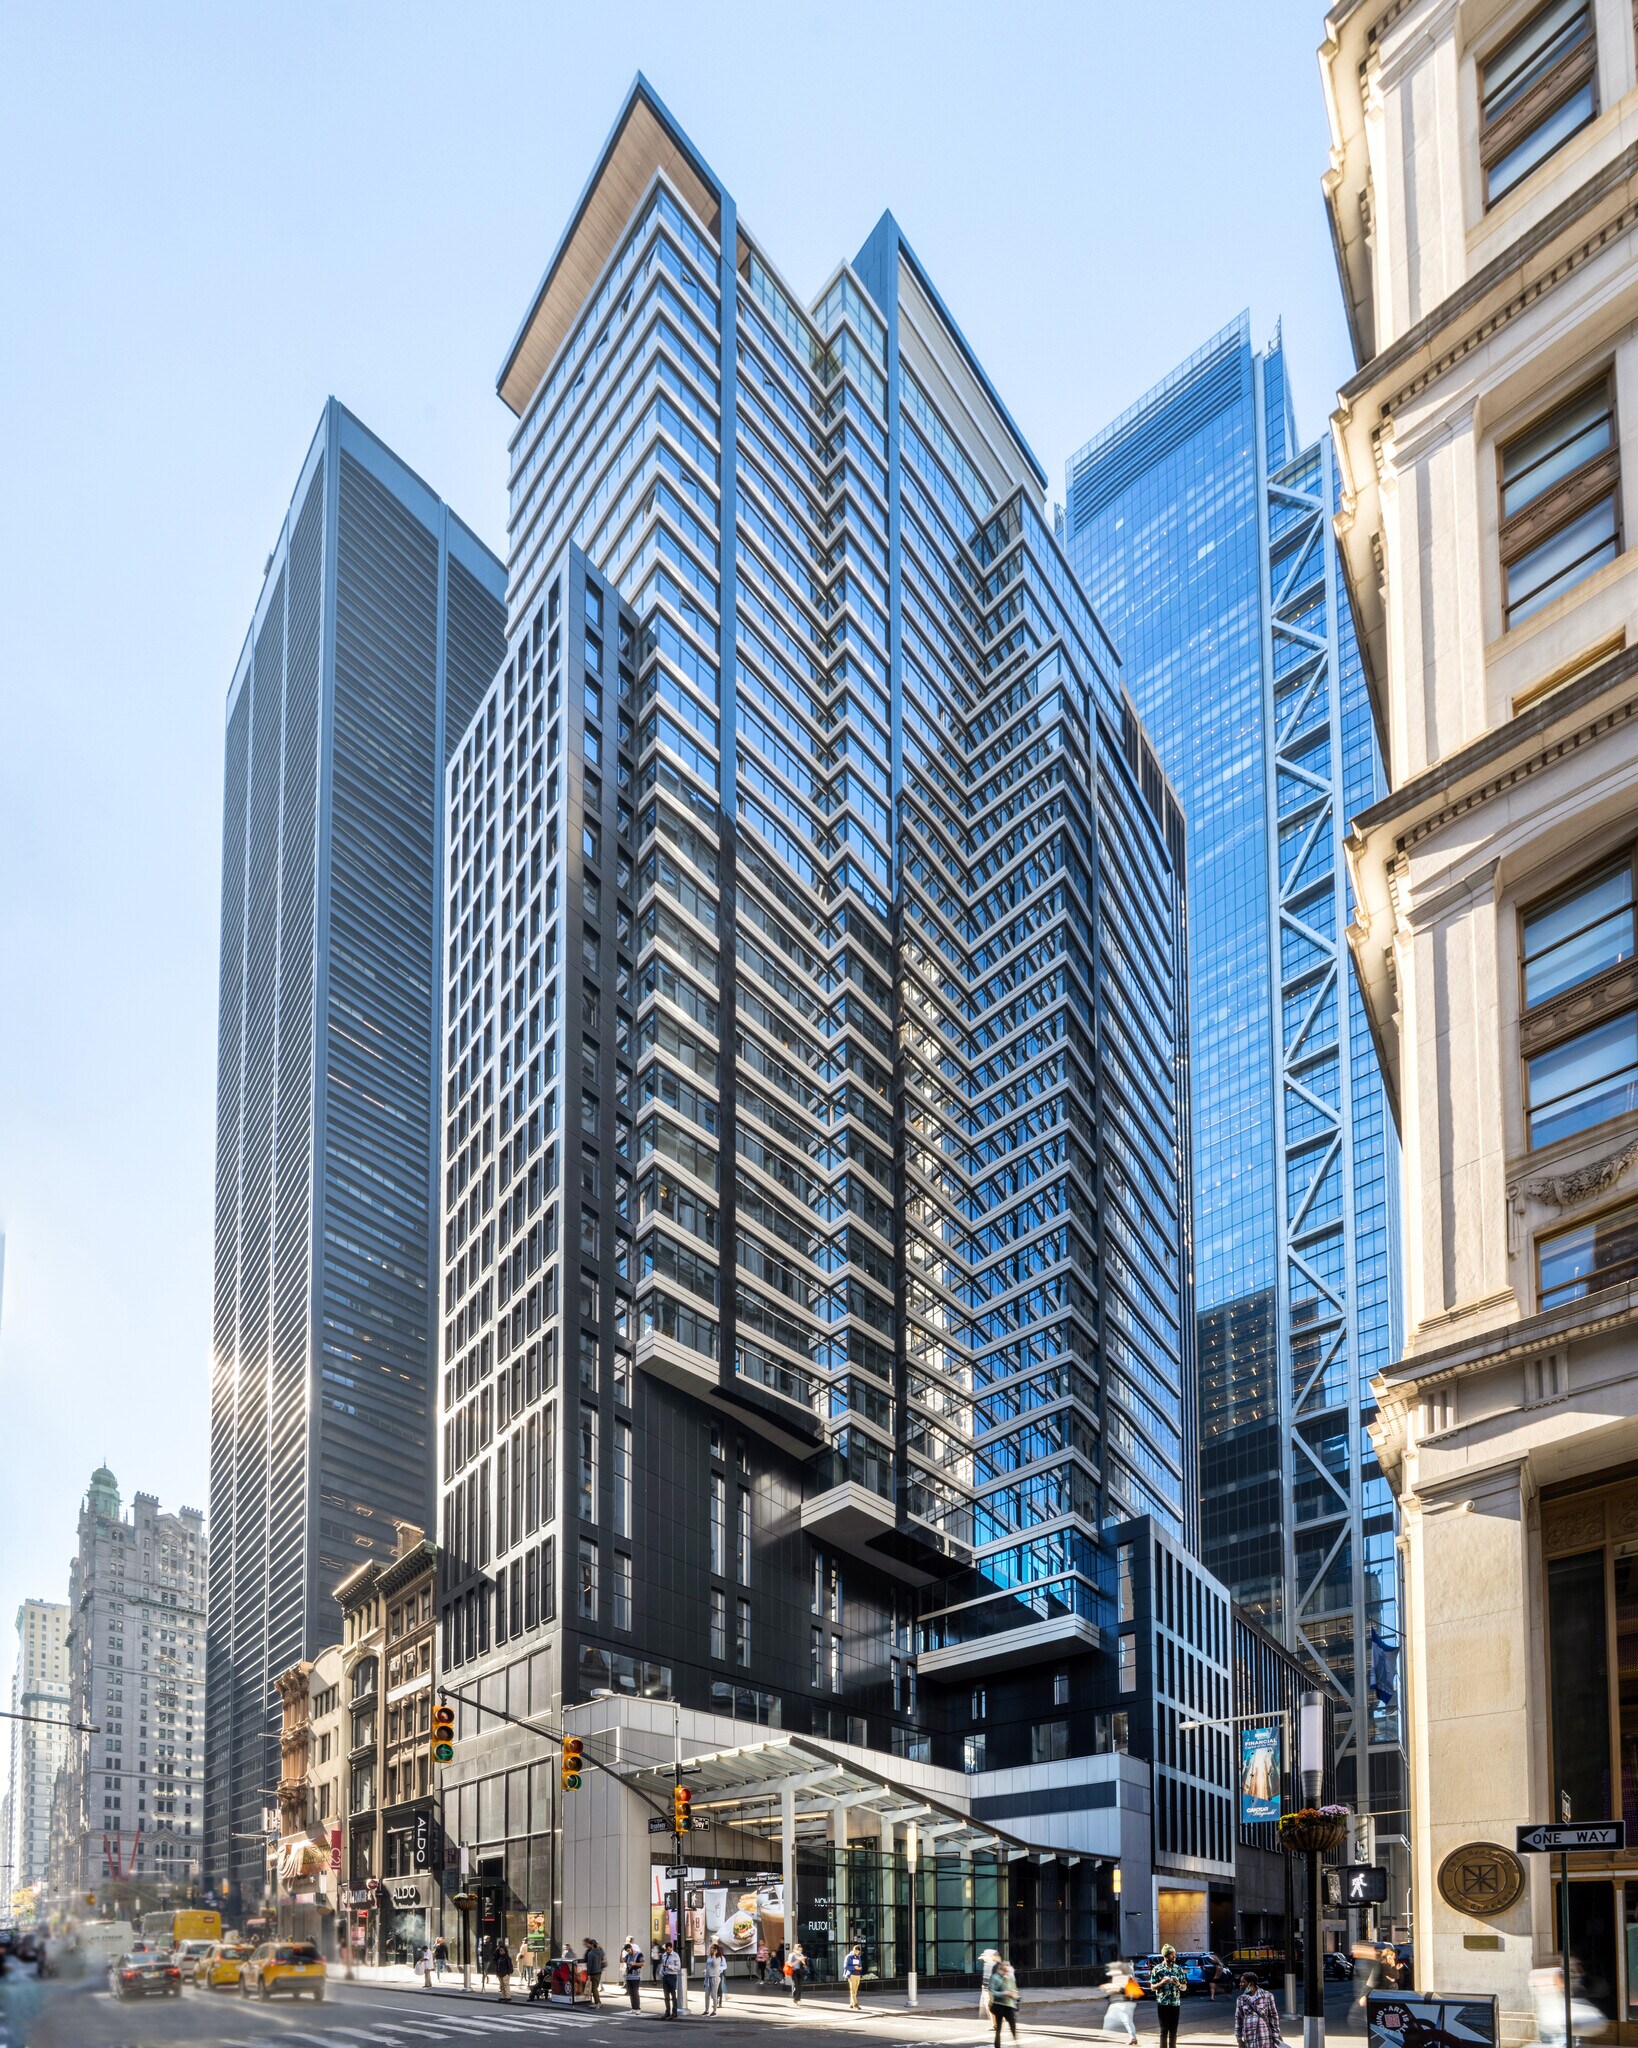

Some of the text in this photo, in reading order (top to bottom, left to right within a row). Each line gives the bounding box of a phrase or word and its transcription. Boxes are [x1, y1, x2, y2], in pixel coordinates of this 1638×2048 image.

[1245, 1739, 1277, 1747] FINANCIAL
[416, 1816, 427, 1863] ALDO
[1533, 1831, 1609, 1844] ONE WAY
[330, 1848, 341, 1868] C21
[392, 1885, 416, 1900] ALDO
[1388, 2005, 1404, 2014] ART
[1402, 2014, 1410, 2022] IS
